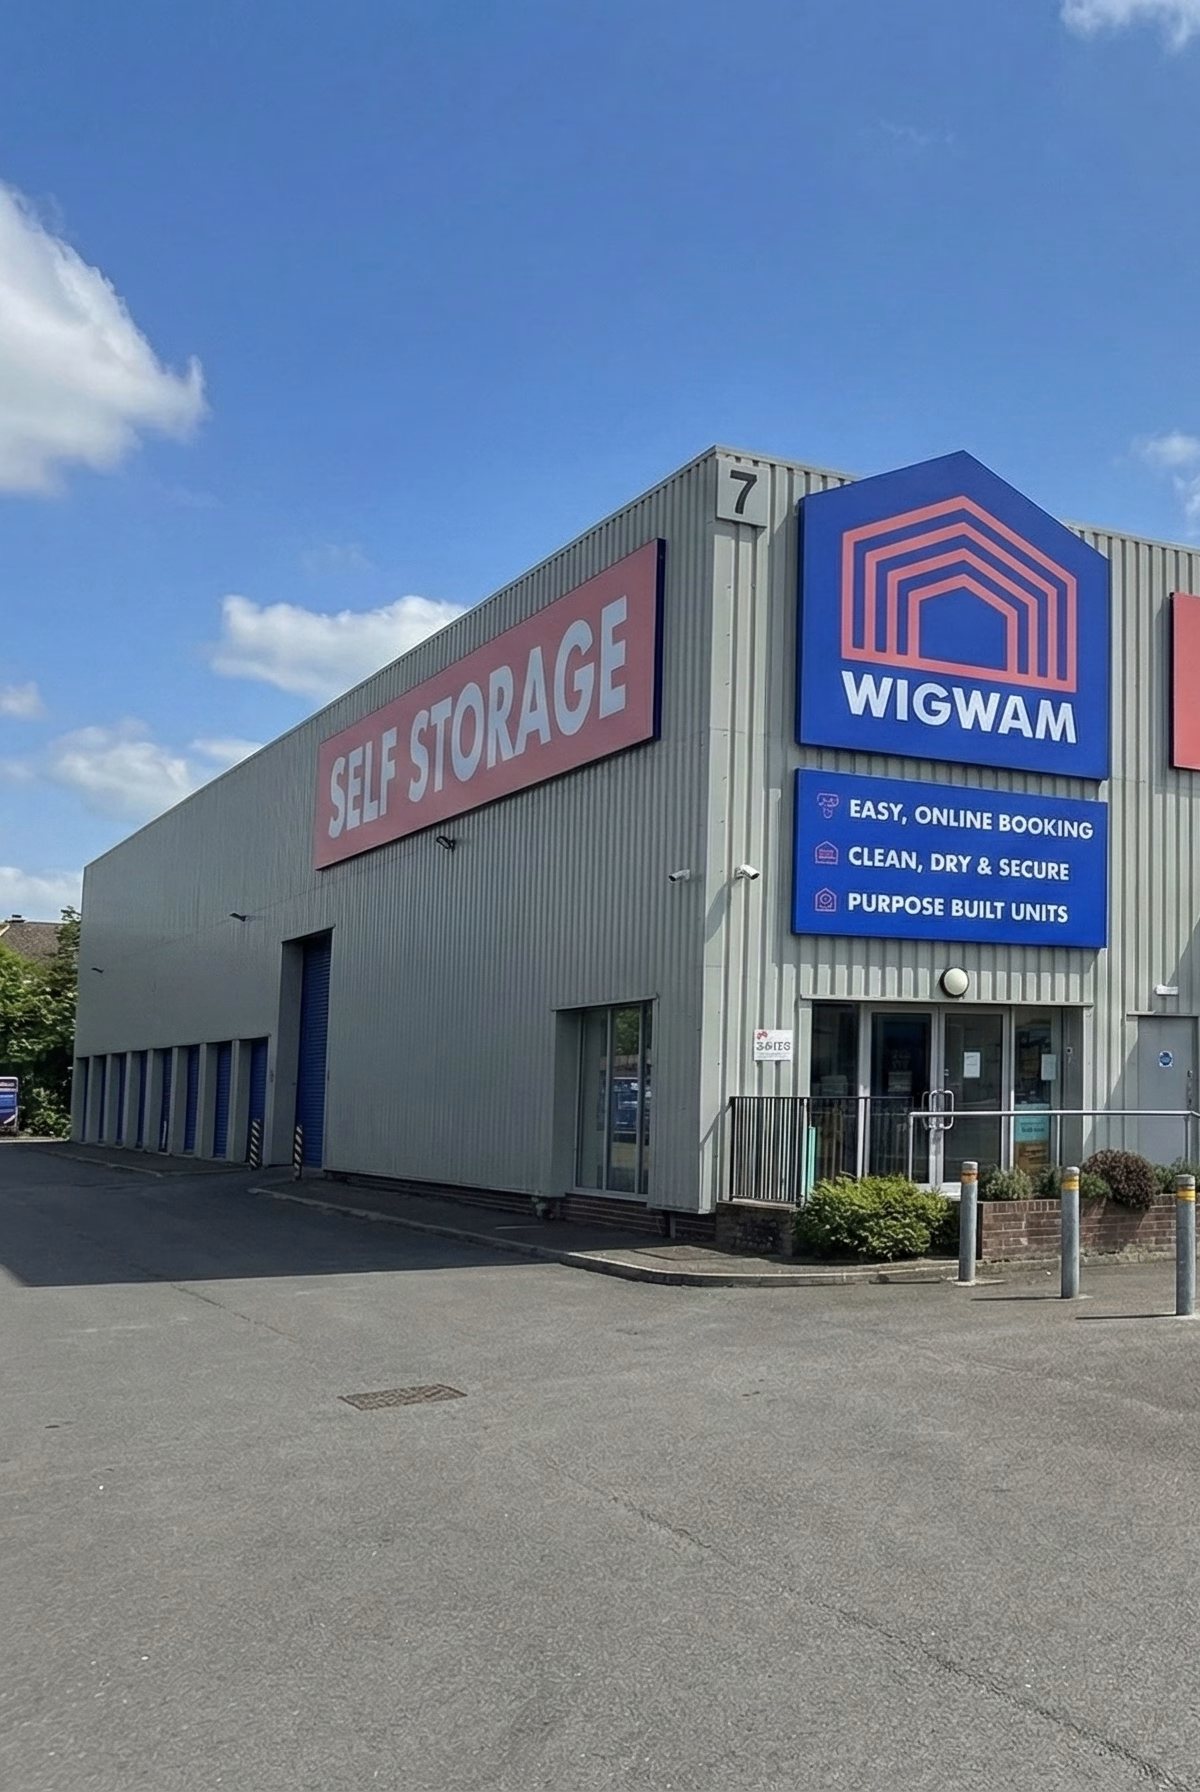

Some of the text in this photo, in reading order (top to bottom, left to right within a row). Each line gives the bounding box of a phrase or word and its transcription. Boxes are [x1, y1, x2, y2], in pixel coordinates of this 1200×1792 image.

[729, 469, 759, 515] 7
[327, 595, 627, 839] SELF STORAGE
[841, 670, 1078, 745] WIGWAM
[849, 799, 1094, 839] EASY, ONLINE BOOKING
[848, 846, 1070, 881] CLEAN, DRY & SECURE
[848, 892, 1069, 923] PURPOSE BUILT UNITS
